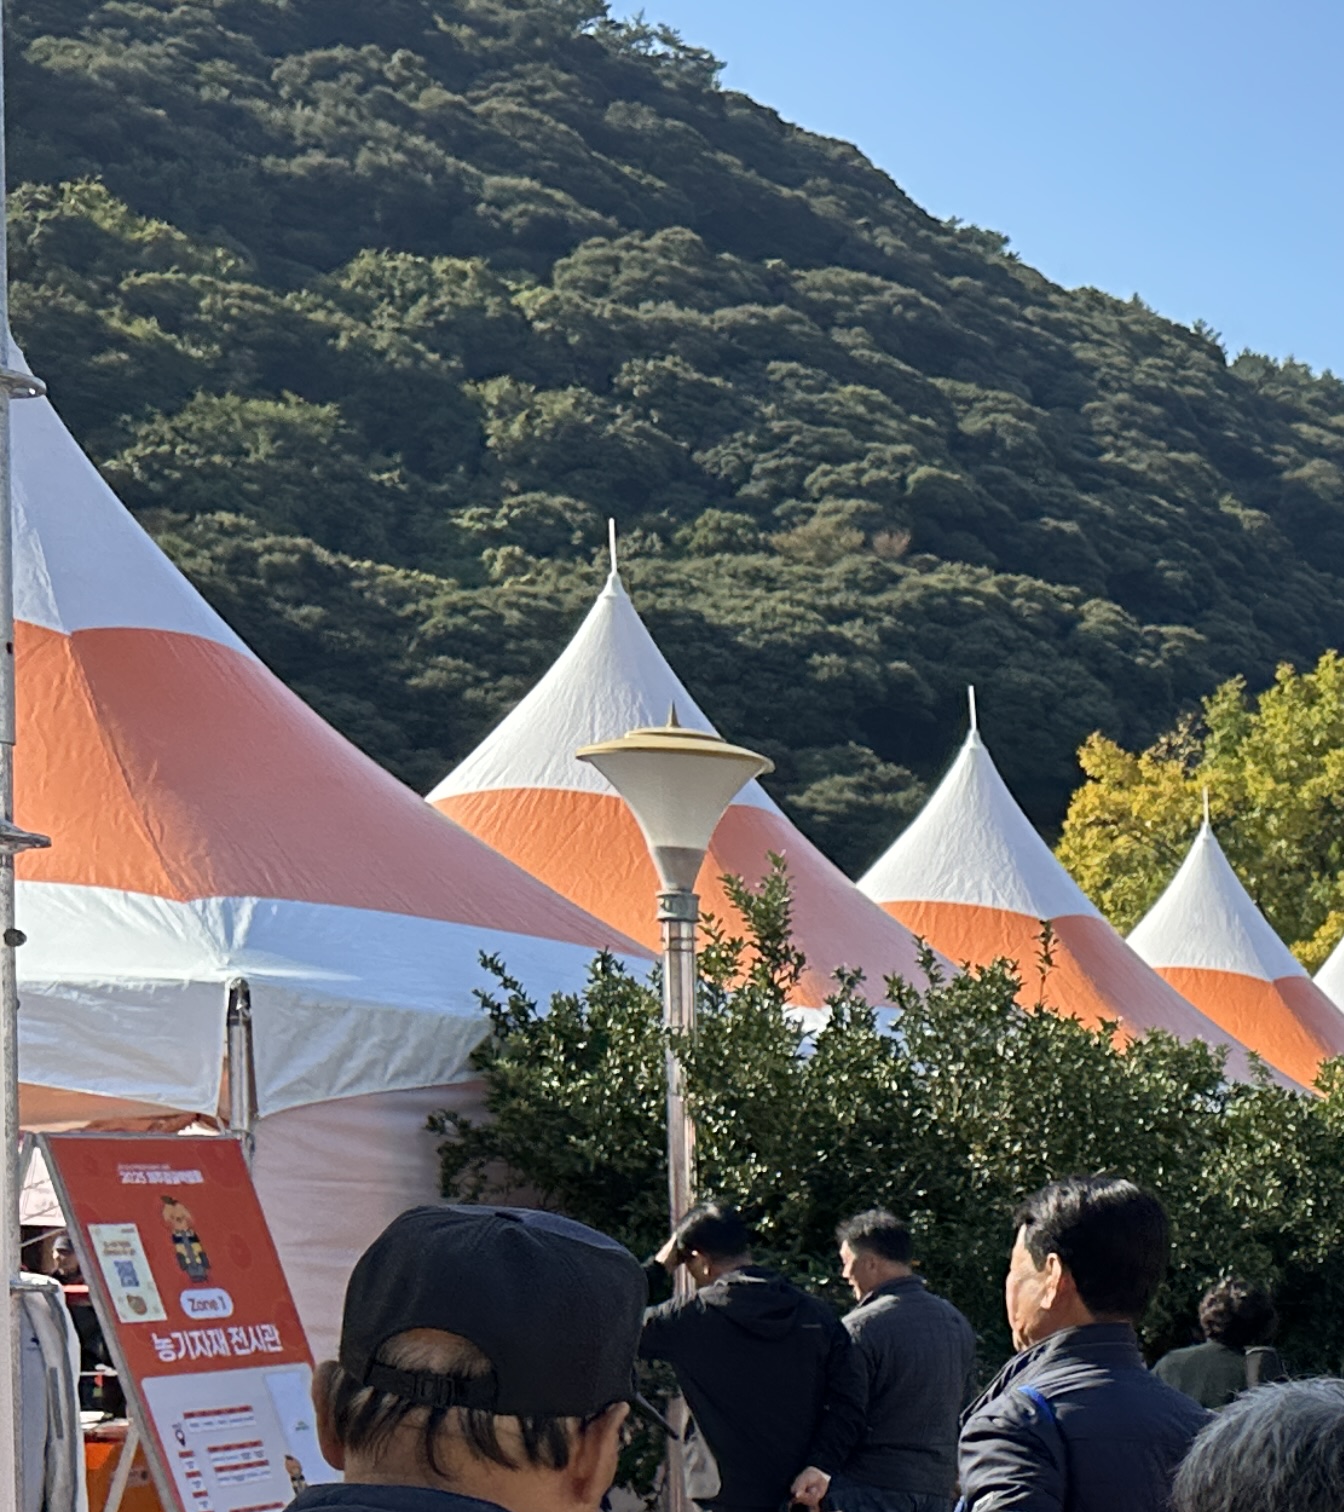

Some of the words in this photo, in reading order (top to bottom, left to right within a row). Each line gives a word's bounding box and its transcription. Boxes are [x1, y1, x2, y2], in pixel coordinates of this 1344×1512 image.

[187, 1297, 217, 1313] Zone
[219, 1296, 227, 1311] 1
[152, 1327, 230, 1362] 농기자재
[228, 1323, 284, 1356] 전시관
